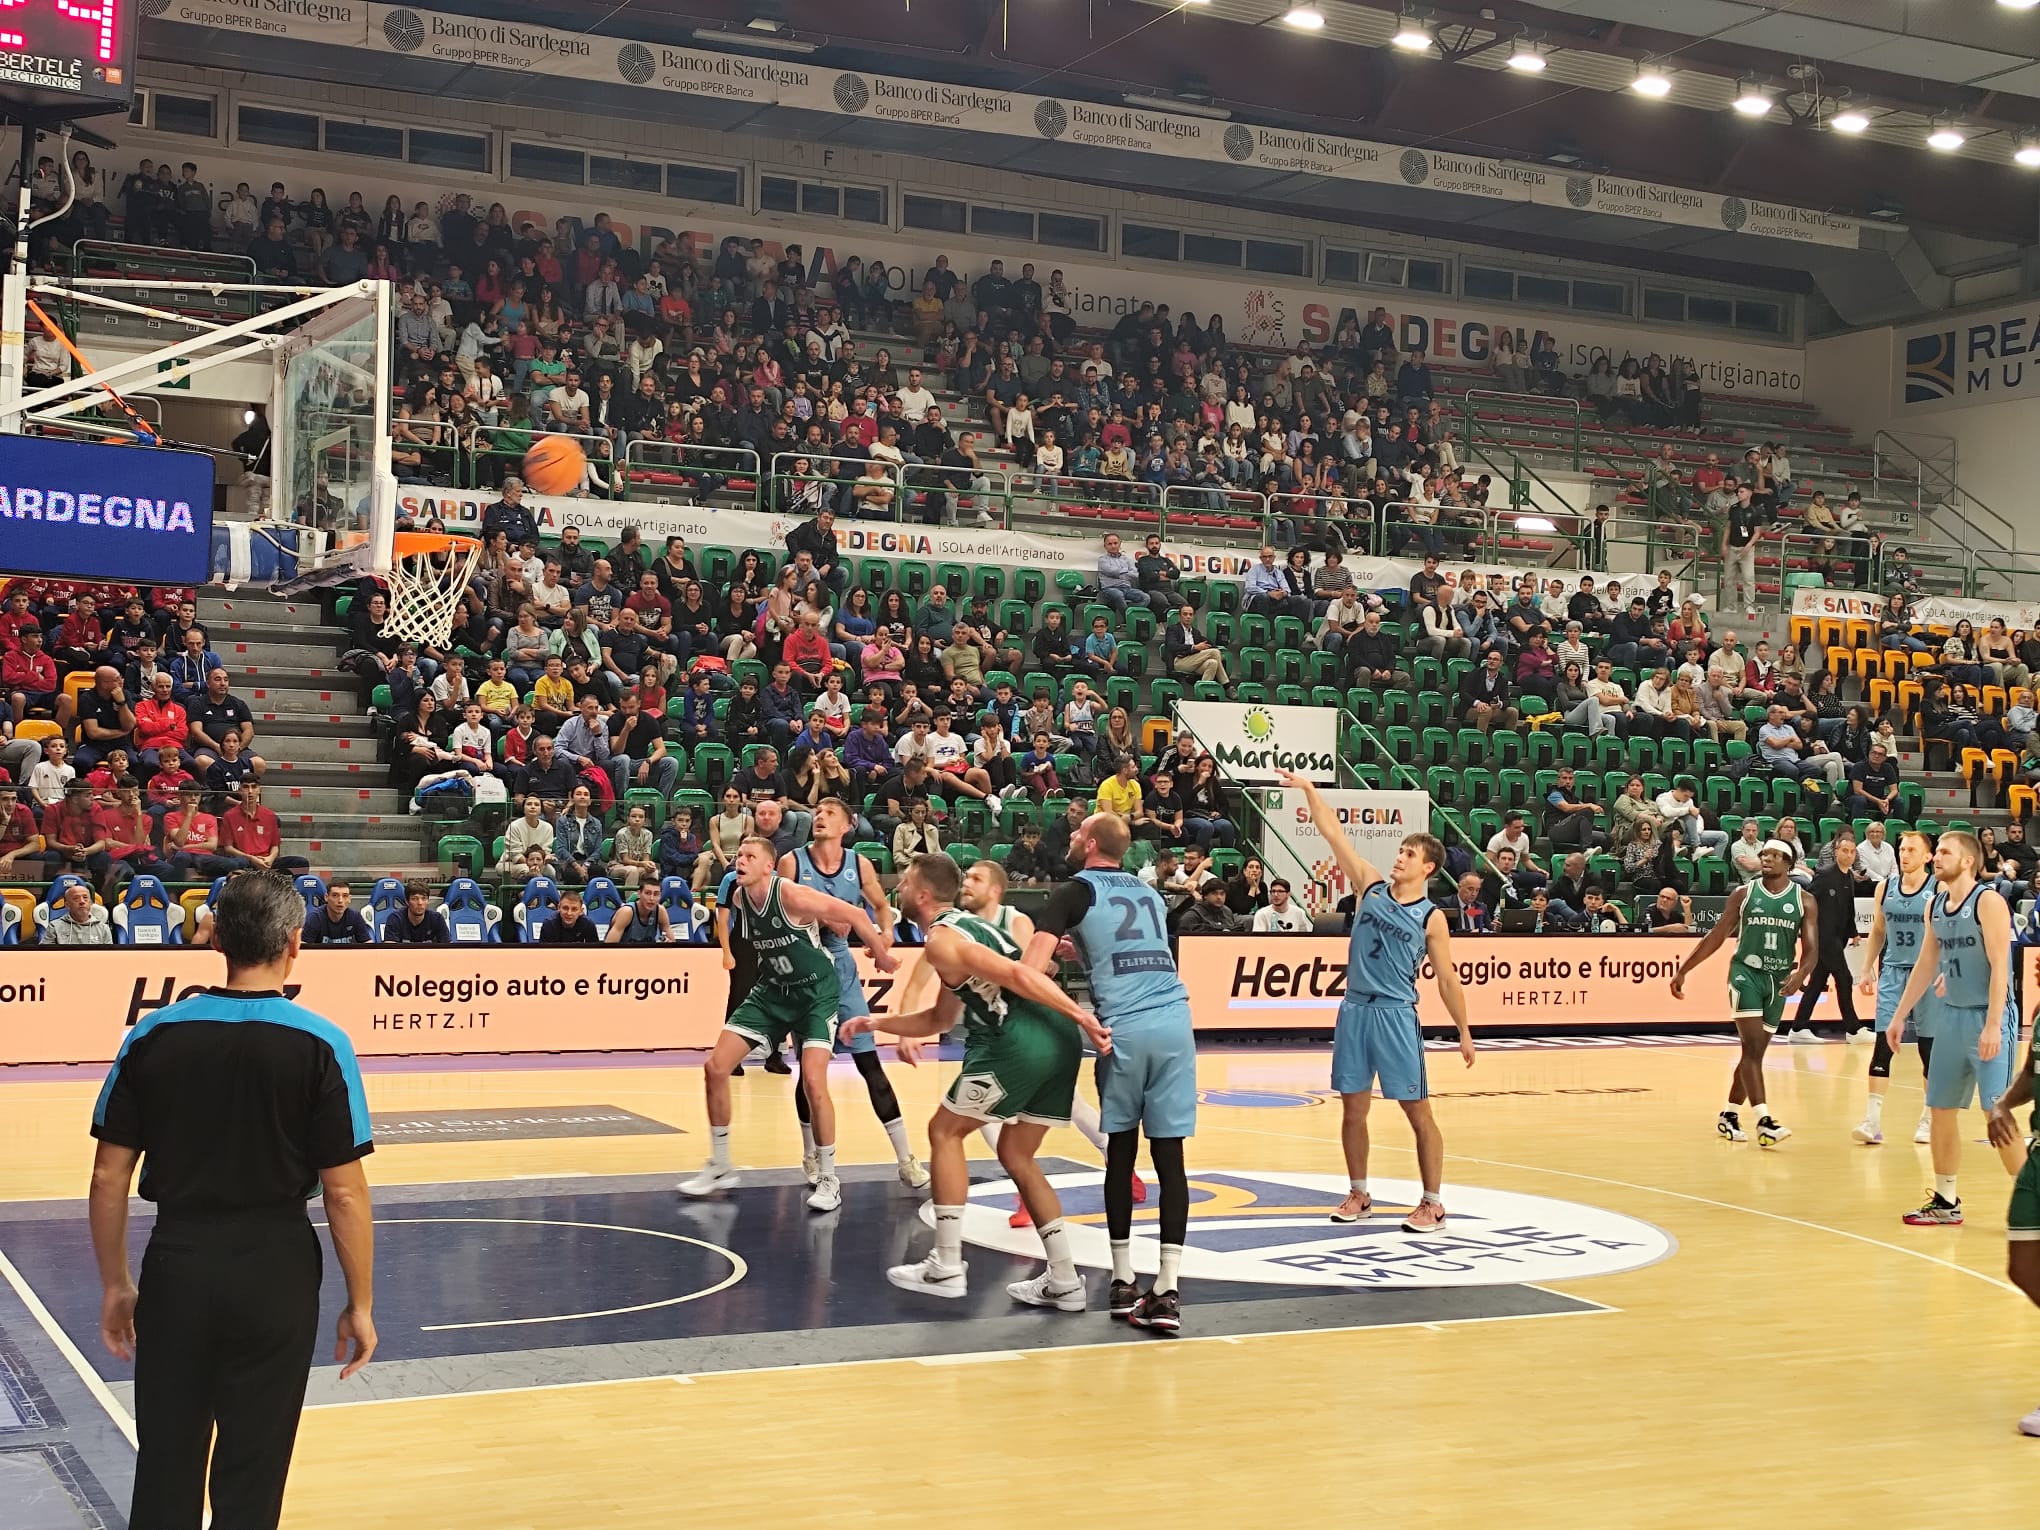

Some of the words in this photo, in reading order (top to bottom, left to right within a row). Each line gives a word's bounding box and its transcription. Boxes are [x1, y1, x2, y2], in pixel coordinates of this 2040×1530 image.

[180, 7, 223, 25] Gruppo
[225, 15, 253, 28] BPER
[255, 18, 287, 33] Banca
[266, 0, 351, 23] Sardegna
[432, 16, 487, 41] Banco
[490, 26, 505, 44] di
[509, 28, 590, 56] Sardegna
[432, 44, 472, 60] Gruppo
[473, 50, 498, 63] BPER
[502, 53, 531, 67] Banca
[661, 50, 709, 74] Banco
[716, 58, 731, 76] di
[734, 60, 809, 88] Sardegna
[663, 76, 699, 93] Gruppo
[701, 81, 724, 95] BPER
[726, 84, 754, 98] Banca
[875, 79, 921, 101] Banco
[924, 86, 939, 104] di
[942, 88, 1011, 115] Sardegna
[875, 104, 909, 120] Gruppo
[911, 108, 933, 121] BPER
[934, 111, 960, 125] Banca
[1072, 105, 1116, 127] Banco
[1119, 113, 1132, 129] di
[1135, 115, 1200, 139] Sardegna
[1073, 130, 1105, 146] Gruppo
[1106, 134, 1126, 147] BPER
[1128, 137, 1152, 150] Banca
[1259, 130, 1300, 150] Banco
[1302, 136, 1315, 152] di
[1317, 138, 1378, 162] Sardegna
[1259, 153, 1289, 168] Gruppo
[1290, 158, 1307, 169] BPER
[1309, 160, 1333, 173] Banca
[1433, 155, 1472, 175] Banco
[1474, 161, 1486, 176] di
[1488, 163, 1545, 187] Sardegna
[1433, 178, 1461, 192] Gruppo
[1462, 182, 1481, 193] BPER
[1482, 184, 1503, 197] Banca
[1597, 178, 1634, 199] Banco
[1636, 185, 1647, 200] di
[1649, 187, 1703, 210] Sardegna
[1597, 201, 1625, 215] Gruppo
[1751, 201, 1785, 221] Banco
[1787, 208, 1797, 222] di
[562, 512, 603, 528] ISOLA
[607, 513, 707, 536] dell'Artigianato
[836, 530, 932, 554] RDEGNA
[939, 541, 974, 554] ISOLA
[977, 543, 1065, 561] dell'Artigianato
[1296, 807, 1403, 825] SDEGNA
[1296, 827, 1321, 837] ISOL
[1108, 896, 1163, 941] 21
[1359, 912, 1413, 942] DNIPRO
[1747, 916, 1796, 930] SARDINIA
[1368, 939, 1382, 960] 2
[1764, 932, 1778, 950] 11
[1896, 931, 1915, 947] 33
[1230, 956, 1348, 998] Hertz
[1416, 955, 1511, 986] oggio
[1519, 961, 1571, 979] auto
[1579, 963, 1592, 979] e
[1600, 955, 1680, 984] furgoni
[374, 973, 499, 1002] Noleggio
[506, 975, 566, 997] auto
[574, 977, 590, 997] e
[597, 972, 689, 1001] furgoni
[1502, 990, 1588, 1006] HERTZ.IT
[373, 1012, 491, 1030] HERTZ.IT
[441, 1113, 633, 1127] Sardegna
[1262, 1225, 1588, 1271] REALE
[1336, 1237, 1647, 1282] MUTUA
